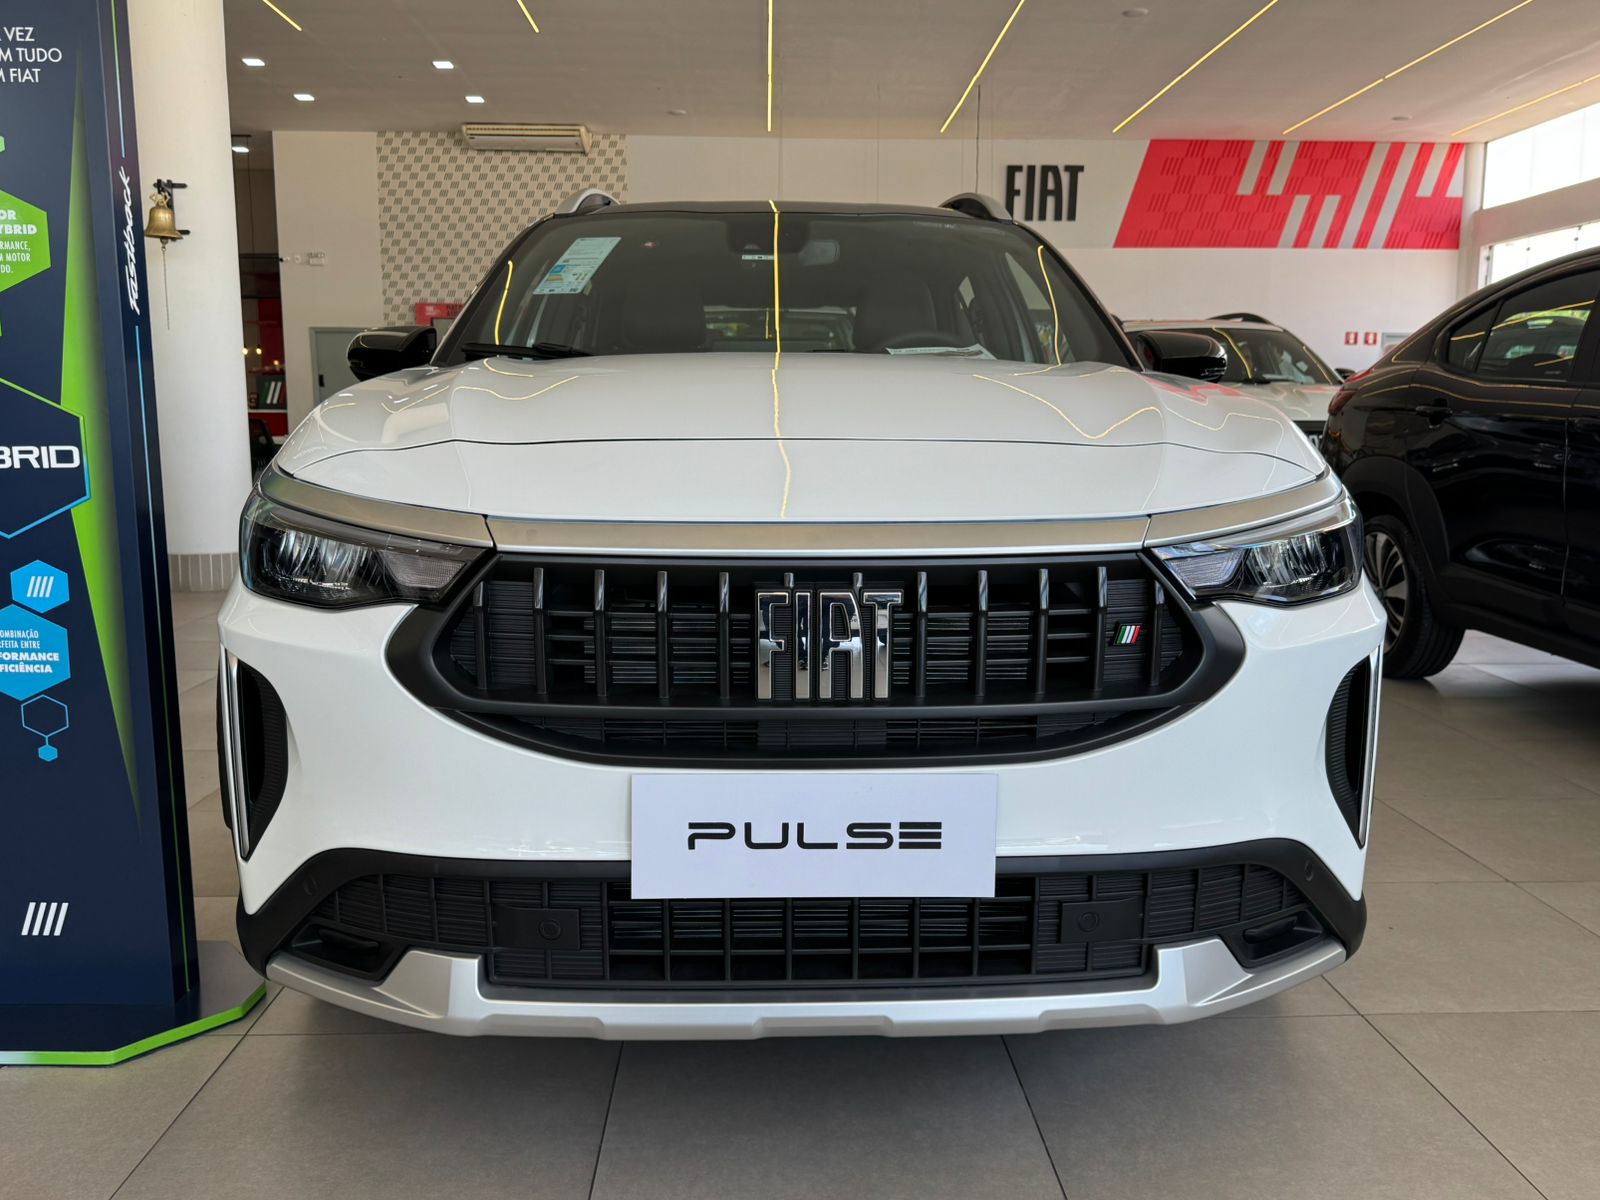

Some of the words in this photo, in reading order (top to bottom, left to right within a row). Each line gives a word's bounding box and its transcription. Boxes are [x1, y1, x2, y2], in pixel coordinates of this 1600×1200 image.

[3, 26, 35, 42] VEZ
[15, 47, 62, 62] TUDO
[9, 68, 41, 83] FIAT
[1005, 164, 1084, 222] FIAT
[5, 252, 31, 262] MOTOR
[0, 445, 80, 469] BRID
[20, 640, 41, 649] ENTRE
[757, 592, 902, 699] FIAT
[688, 821, 942, 850] PULSE
